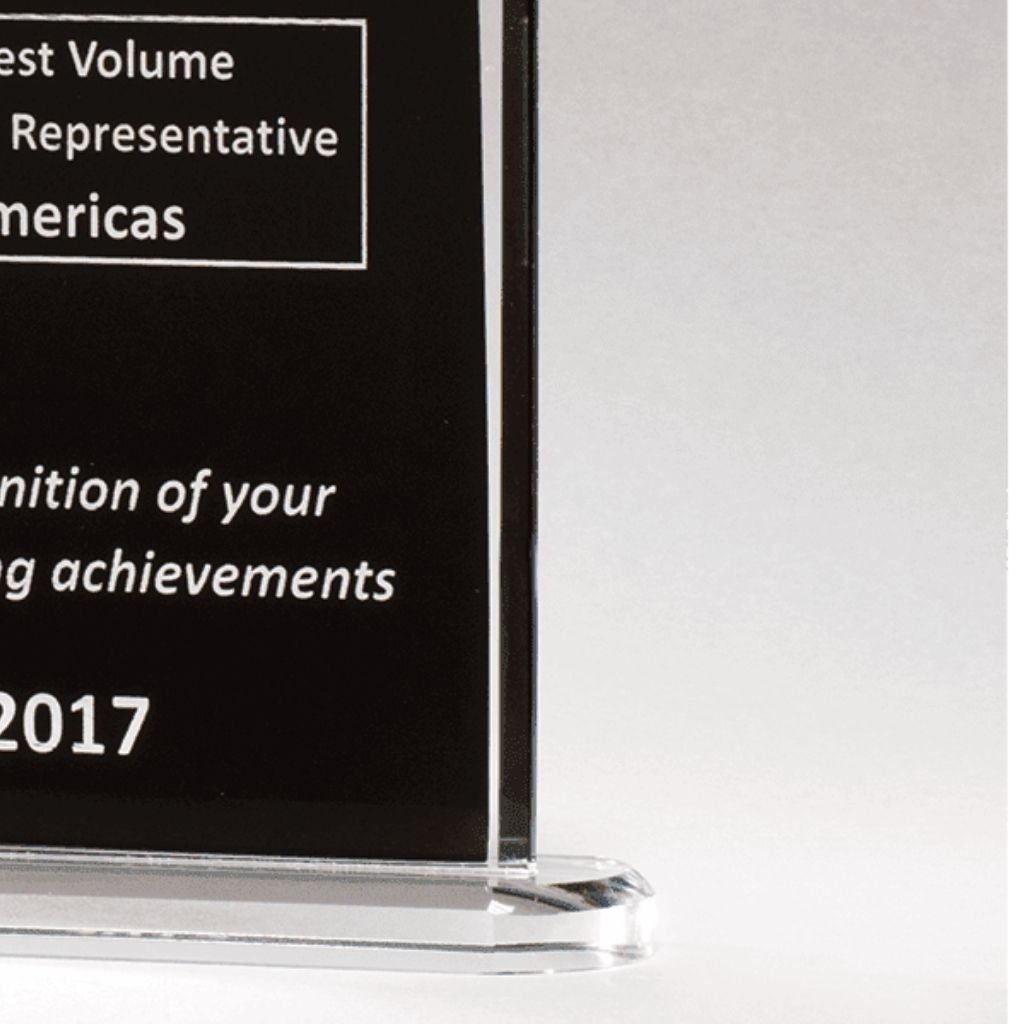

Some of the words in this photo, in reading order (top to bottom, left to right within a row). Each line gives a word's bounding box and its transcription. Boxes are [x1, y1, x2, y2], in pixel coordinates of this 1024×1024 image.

[67, 38, 235, 81] Volume
[11, 113, 338, 161] Representative
[157, 468, 212, 524] of
[221, 481, 337, 525] your
[51, 547, 396, 602] achievements
